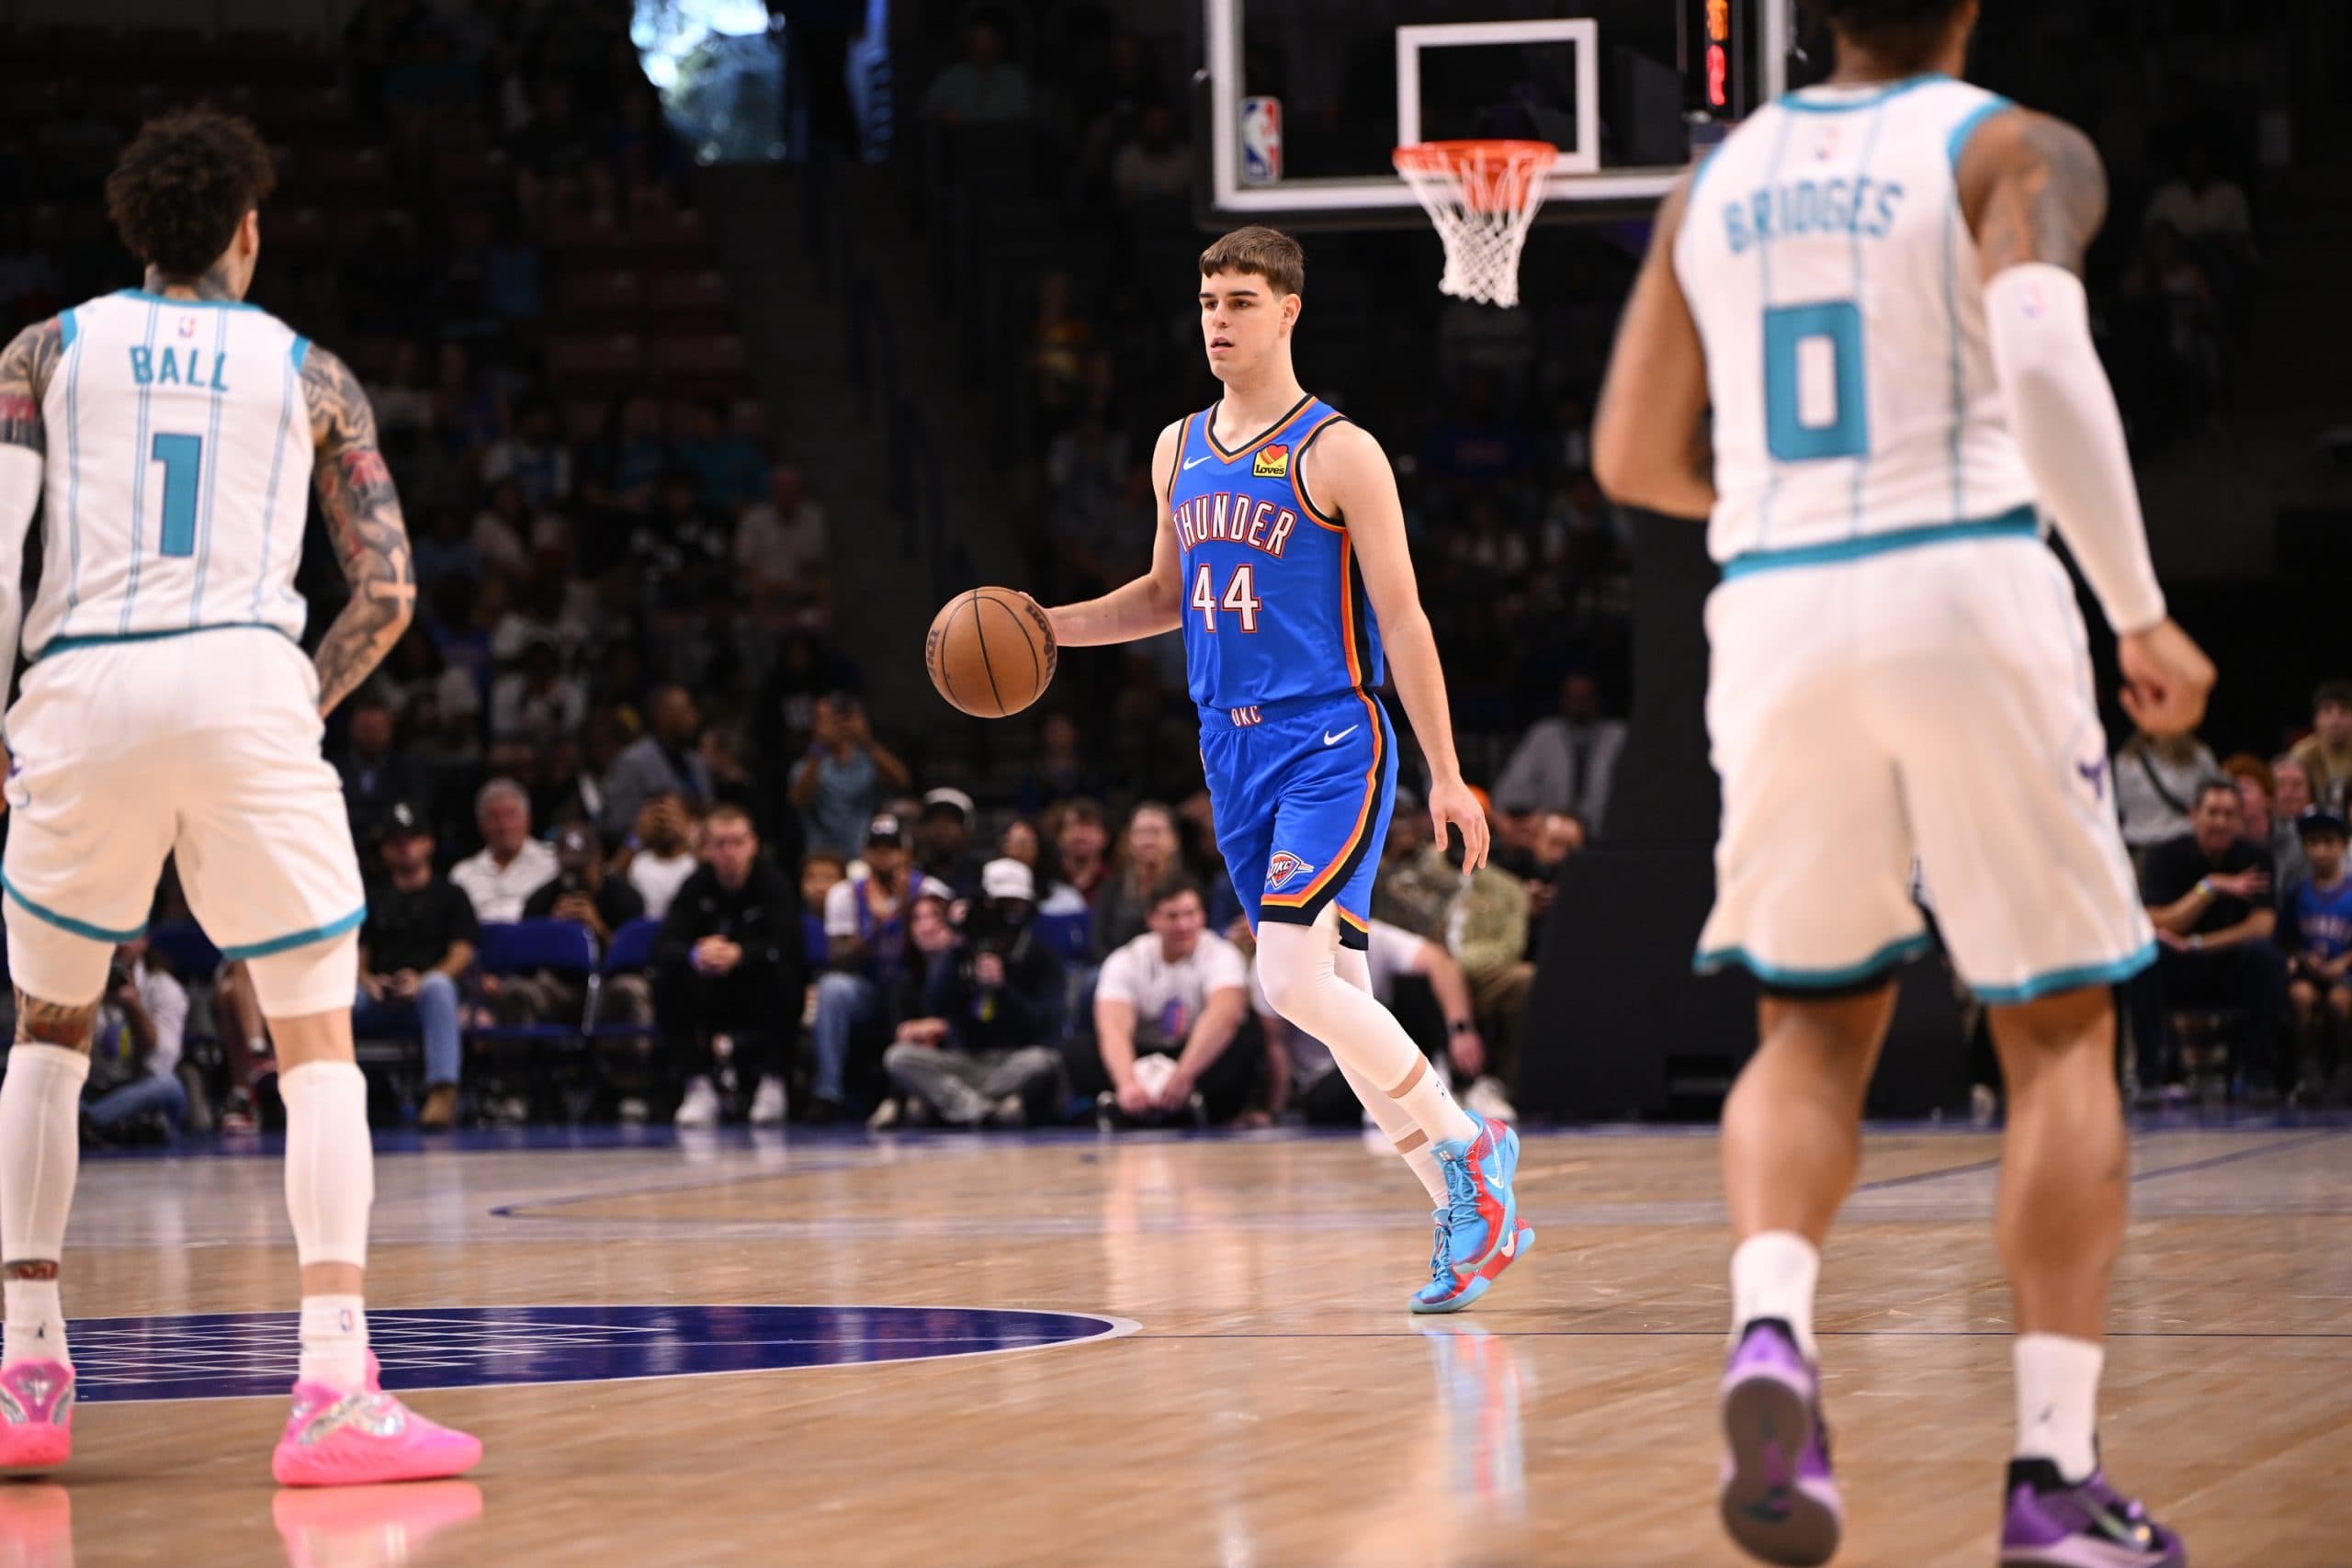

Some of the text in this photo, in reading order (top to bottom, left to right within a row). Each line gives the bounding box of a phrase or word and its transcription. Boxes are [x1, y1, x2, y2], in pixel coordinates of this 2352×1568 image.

[1723, 176, 1904, 254] BRIDGES
[130, 346, 228, 392] BALL
[1762, 299, 1869, 464] 0
[151, 433, 202, 558] 1
[1173, 492, 1296, 558] THUNDER
[1192, 563, 1261, 633] 44
[1230, 705, 1261, 727] OKC
